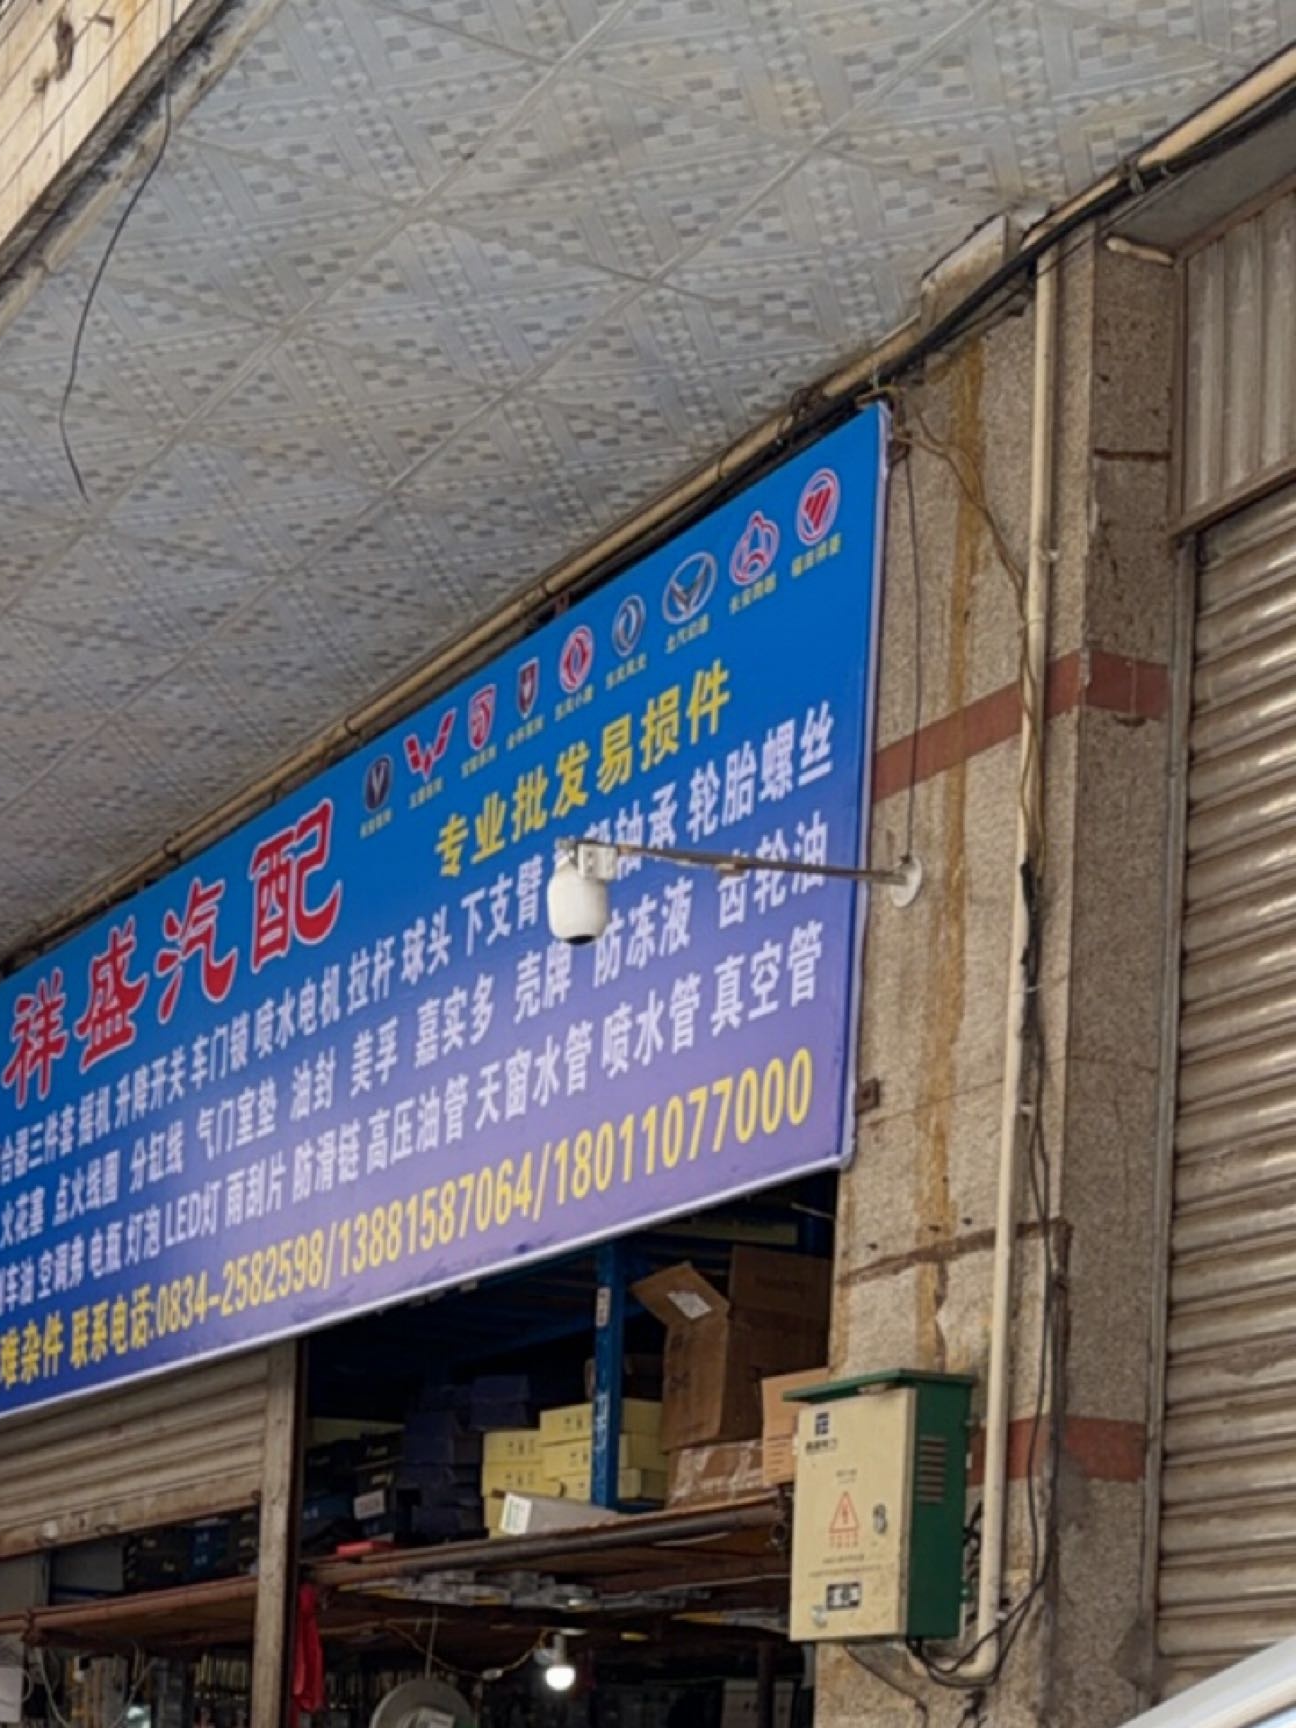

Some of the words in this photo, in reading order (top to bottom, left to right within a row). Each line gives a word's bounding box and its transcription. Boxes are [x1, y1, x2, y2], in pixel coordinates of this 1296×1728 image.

[252, 963, 342, 1060] 喷水电机
[345, 935, 395, 1016] 拉杆
[399, 905, 452, 986] 球头
[460, 853, 543, 957] 下支臂
[679, 701, 833, 867] 轮胎螺丝
[434, 658, 730, 877] 专业批发易损件
[124, 1203, 161, 1264] 灯泡
[164, 1178, 223, 1247] LED灯
[224, 1150, 287, 1227] 雨刮片
[291, 1119, 361, 1203] 防滑链
[365, 1073, 469, 1175] 高压油管
[474, 1020, 593, 1131] 天窗水管
[600, 975, 701, 1079] 喷水管
[709, 922, 823, 1037] 真空管
[195, 1077, 278, 1161] 气门室垫
[288, 1047, 336, 1123] 油封
[349, 1015, 399, 1099] 美孚
[414, 973, 494, 1069] 嘉实多
[514, 941, 572, 1024] 壳牌
[593, 877, 692, 990] 防冻液
